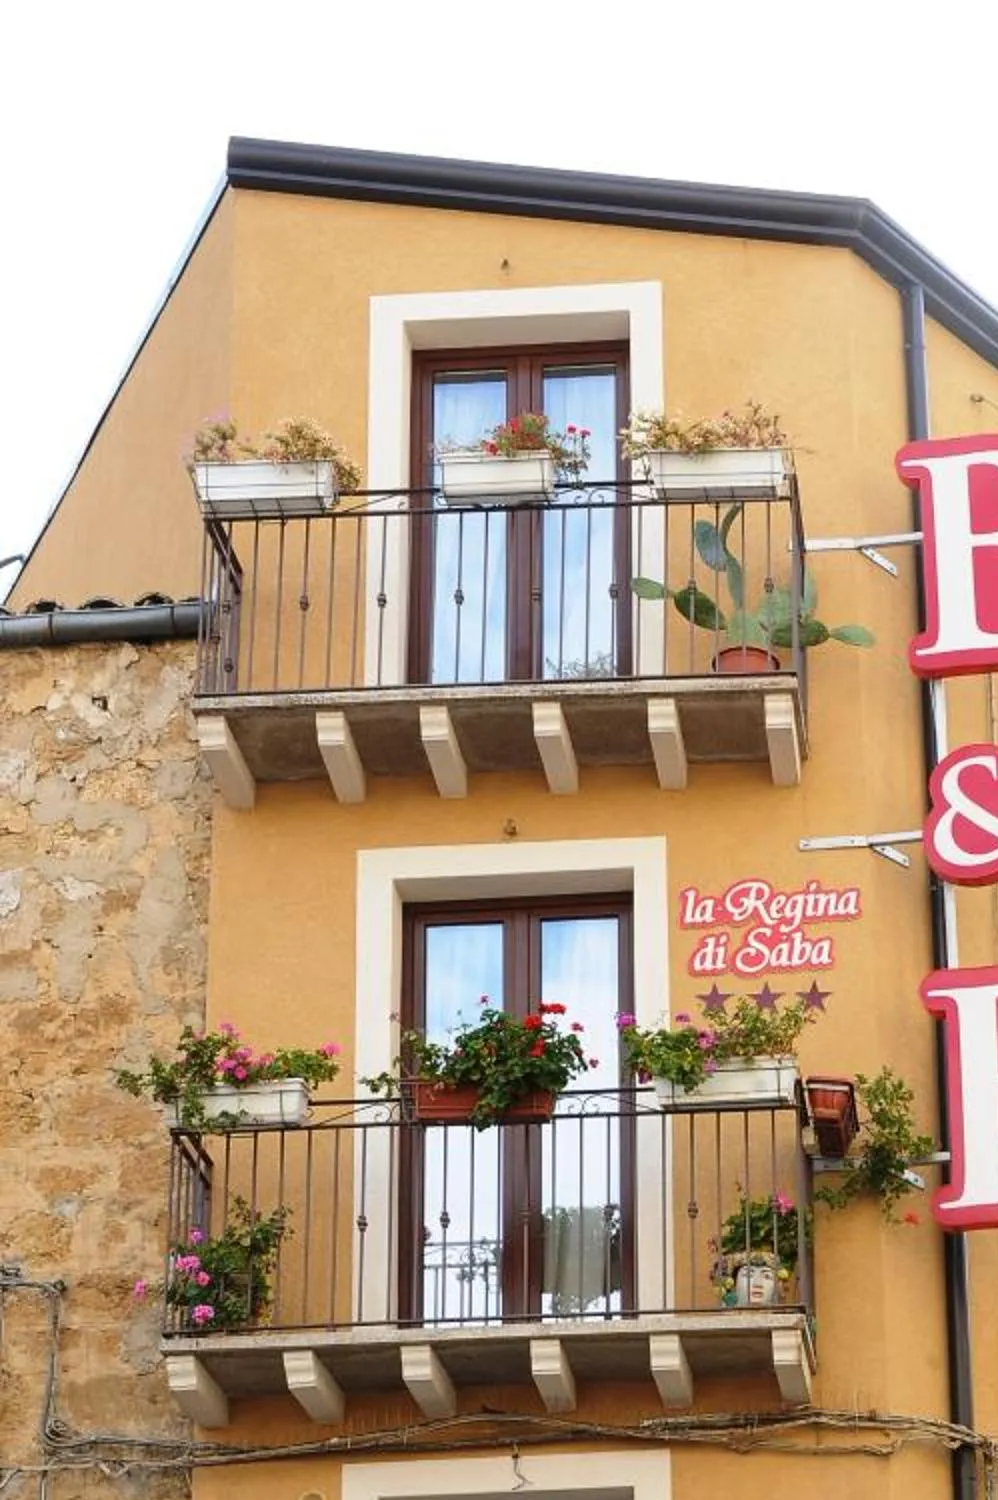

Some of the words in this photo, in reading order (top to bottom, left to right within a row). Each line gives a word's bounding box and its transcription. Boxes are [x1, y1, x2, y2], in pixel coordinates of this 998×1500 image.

[684, 889, 715, 923] la
[725, 881, 859, 932] Regina
[693, 934, 727, 971] di
[735, 927, 832, 973] Saba
